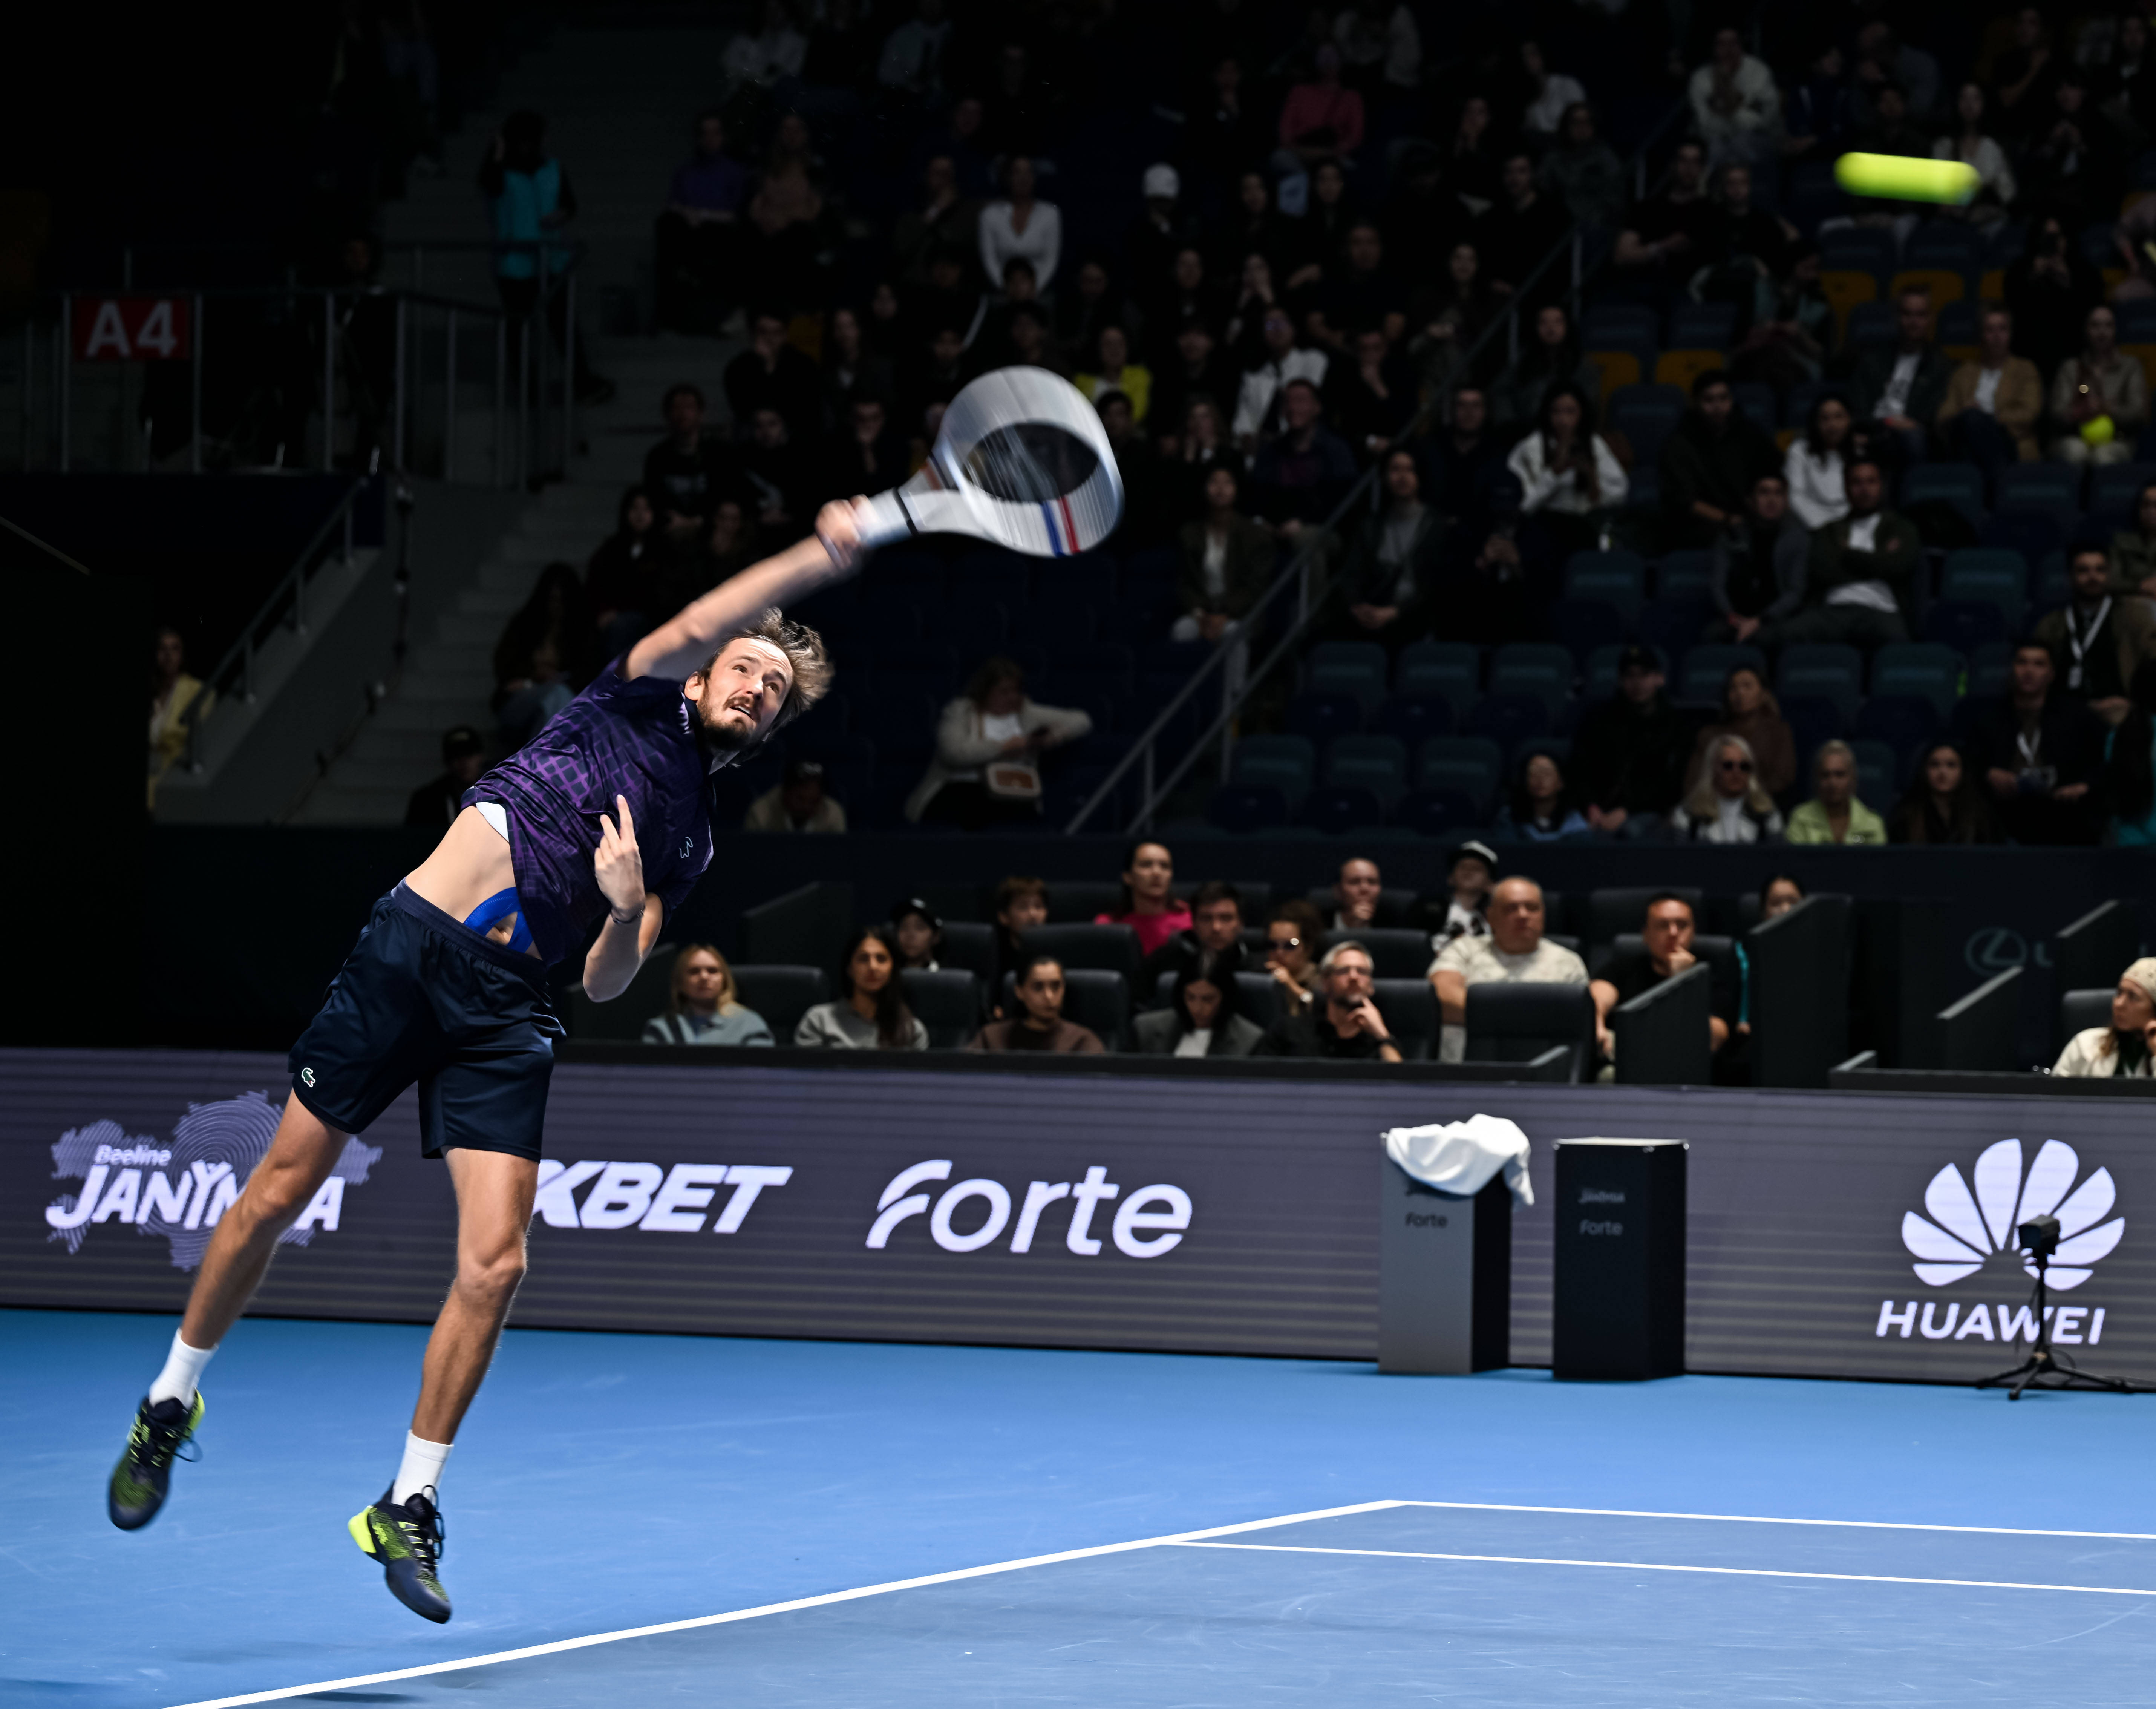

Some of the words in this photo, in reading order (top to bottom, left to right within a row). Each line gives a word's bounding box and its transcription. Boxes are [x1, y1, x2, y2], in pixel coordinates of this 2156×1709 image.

[86, 300, 178, 358] A4
[95, 1144, 172, 1166] Beeline
[45, 1159, 346, 1231] JANYA
[532, 1159, 793, 1234] XBET
[865, 1159, 1193, 1258] Forte
[1876, 1300, 2105, 1345] HUAWEI
